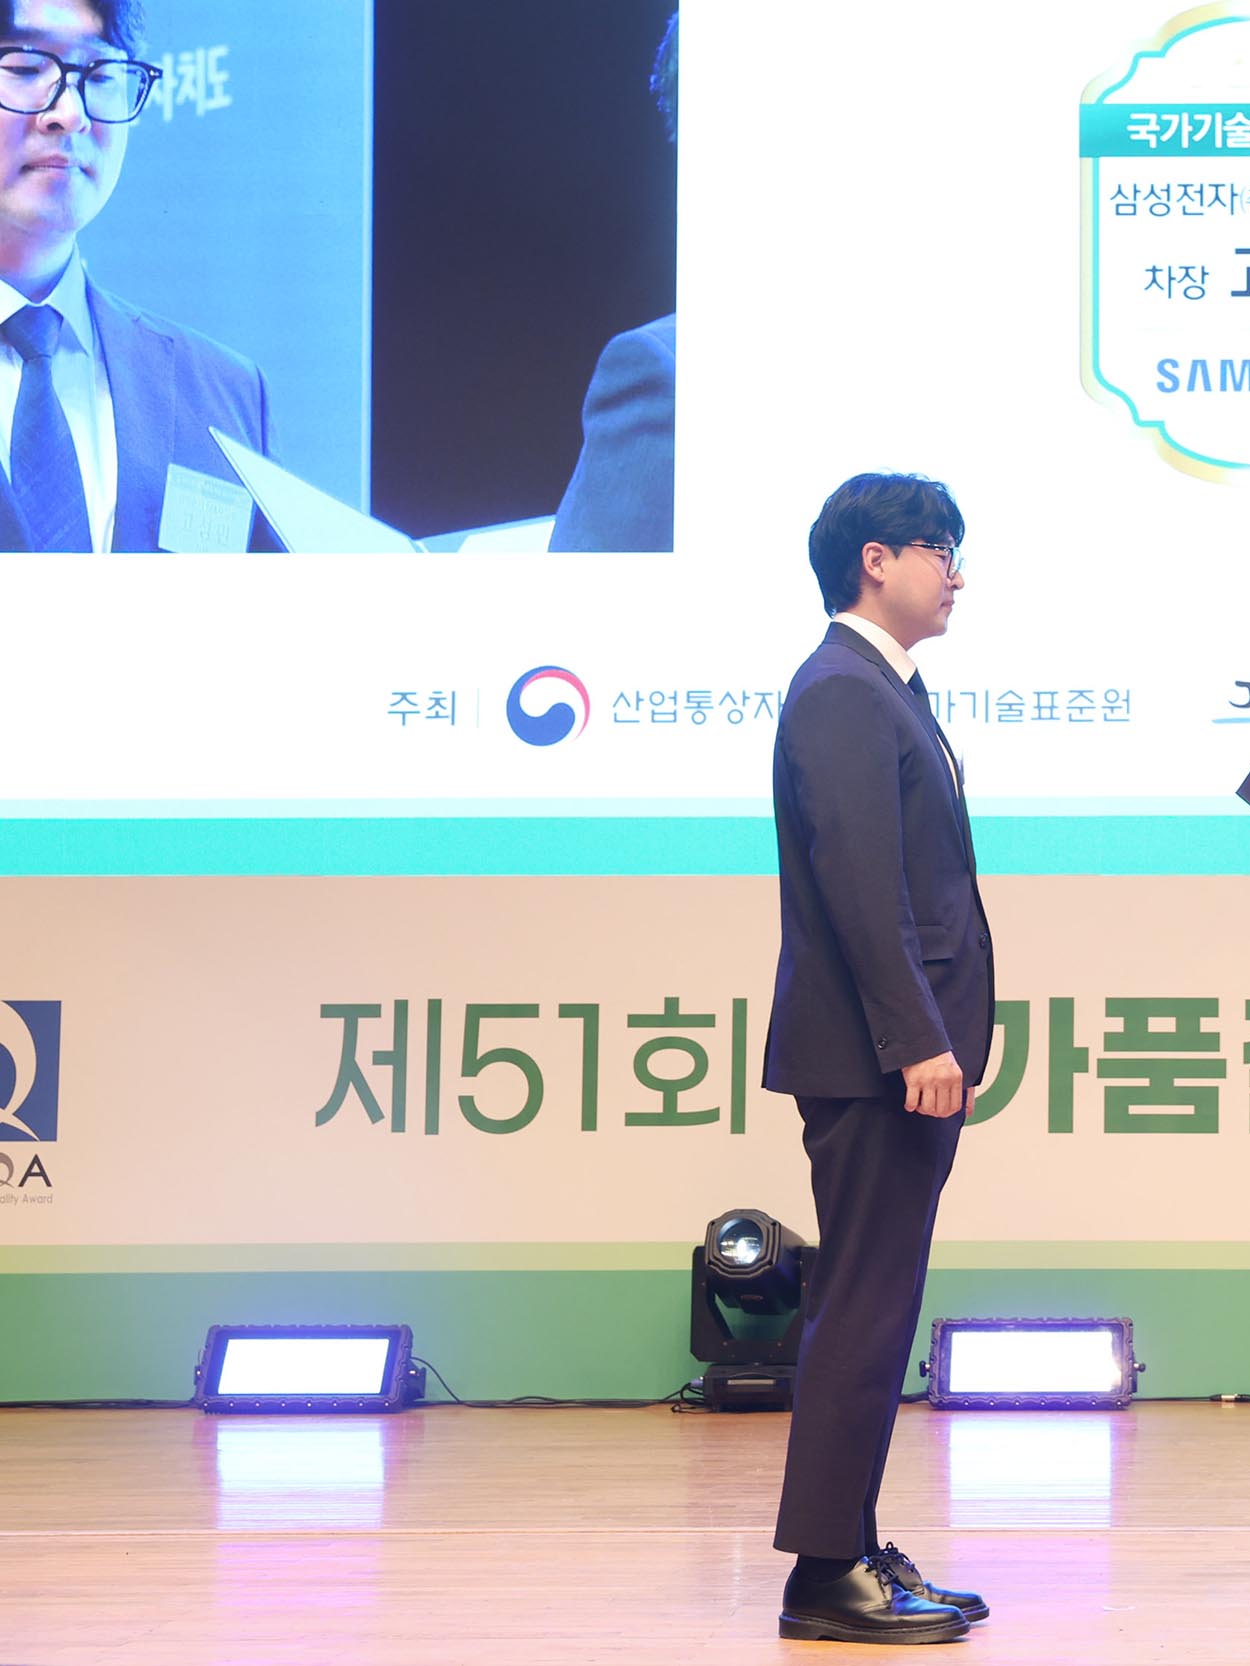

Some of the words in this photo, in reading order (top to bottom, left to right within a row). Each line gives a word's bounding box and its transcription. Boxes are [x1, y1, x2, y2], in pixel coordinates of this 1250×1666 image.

[1143, 264, 1211, 301] 차장
[387, 690, 456, 727] 주최
[315, 997, 747, 1135] 제51회
[22, 1193, 53, 1204] Award
